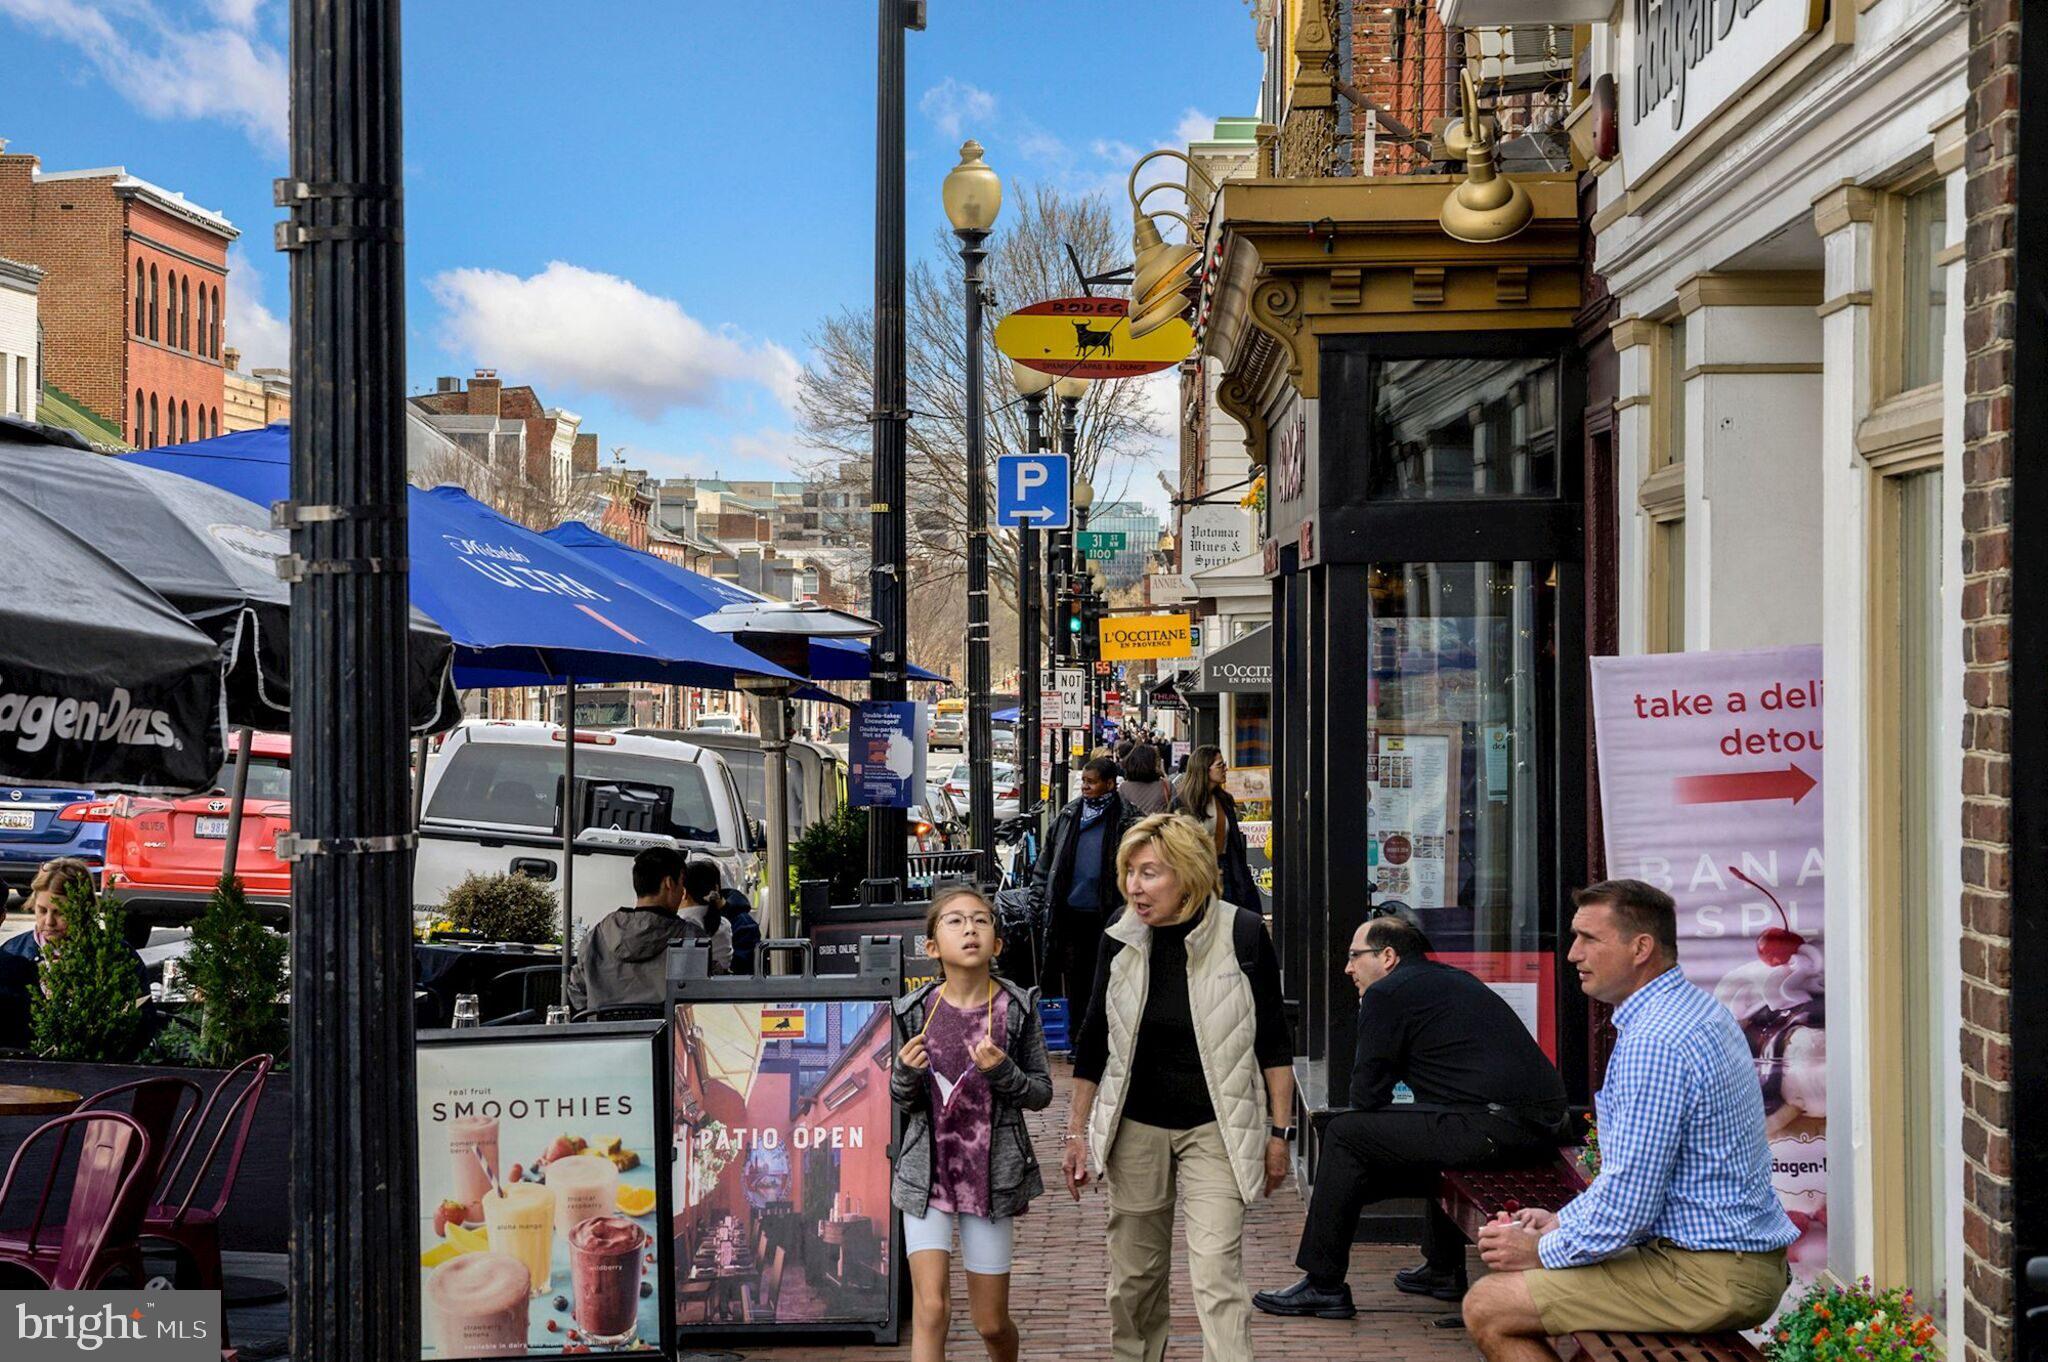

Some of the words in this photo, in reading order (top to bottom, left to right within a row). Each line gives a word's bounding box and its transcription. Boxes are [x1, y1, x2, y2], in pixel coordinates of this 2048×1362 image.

[1052, 302, 1128, 313] BODEG
[1017, 462, 1049, 501] P
[1191, 526, 1240, 539] Potomac
[1092, 534, 1102, 547] 31
[1190, 540, 1227, 552] Wines
[1231, 541, 1241, 552] &
[1089, 549, 1111, 559] 1100
[457, 556, 612, 602] ULTRA
[1061, 675, 1080, 687] NOT
[1634, 690, 1712, 718] take
[1727, 693, 1746, 713] a
[1695, 901, 1819, 937] SPL
[819, 945, 836, 955] ORDER
[838, 944, 858, 954] ONLINE
[449, 1088, 467, 1096] real
[471, 1087, 492, 1095] fruit
[432, 1095, 632, 1122] SMOOTHIES
[699, 1127, 778, 1150] PATIO
[793, 1126, 864, 1149] OPEN
